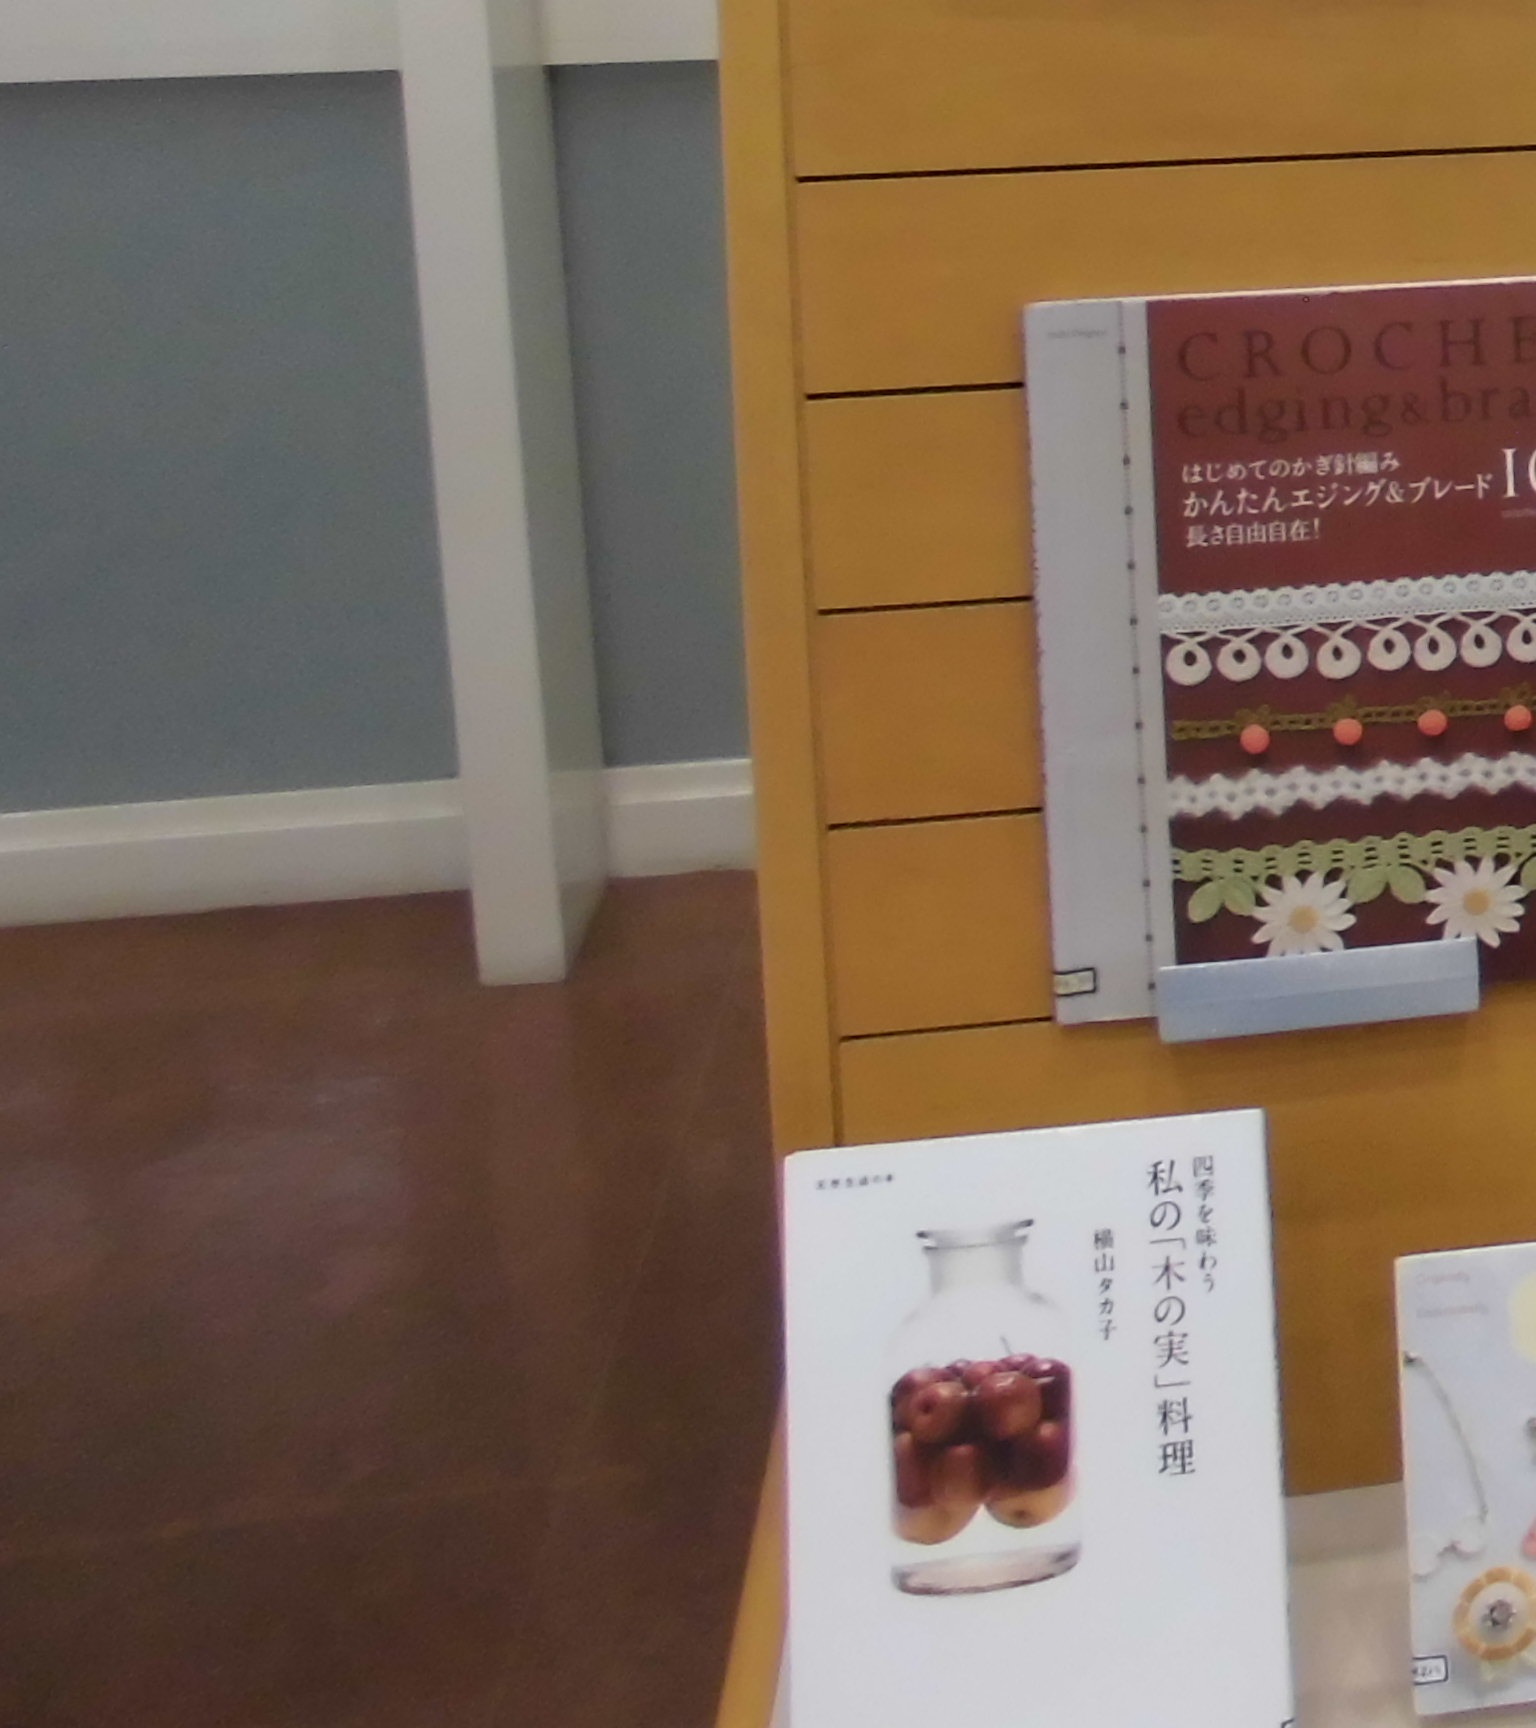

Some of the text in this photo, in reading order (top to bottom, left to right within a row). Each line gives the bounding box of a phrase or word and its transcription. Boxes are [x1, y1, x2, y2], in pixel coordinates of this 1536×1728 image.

[1182, 451, 1401, 483] はじめてのかぎ針編み
[1093, 1228, 1117, 1341] 横山タカ子
[1192, 1155, 1218, 1293] 四季を味わう
[1146, 1159, 1195, 1477] 私の「木の実」料理
